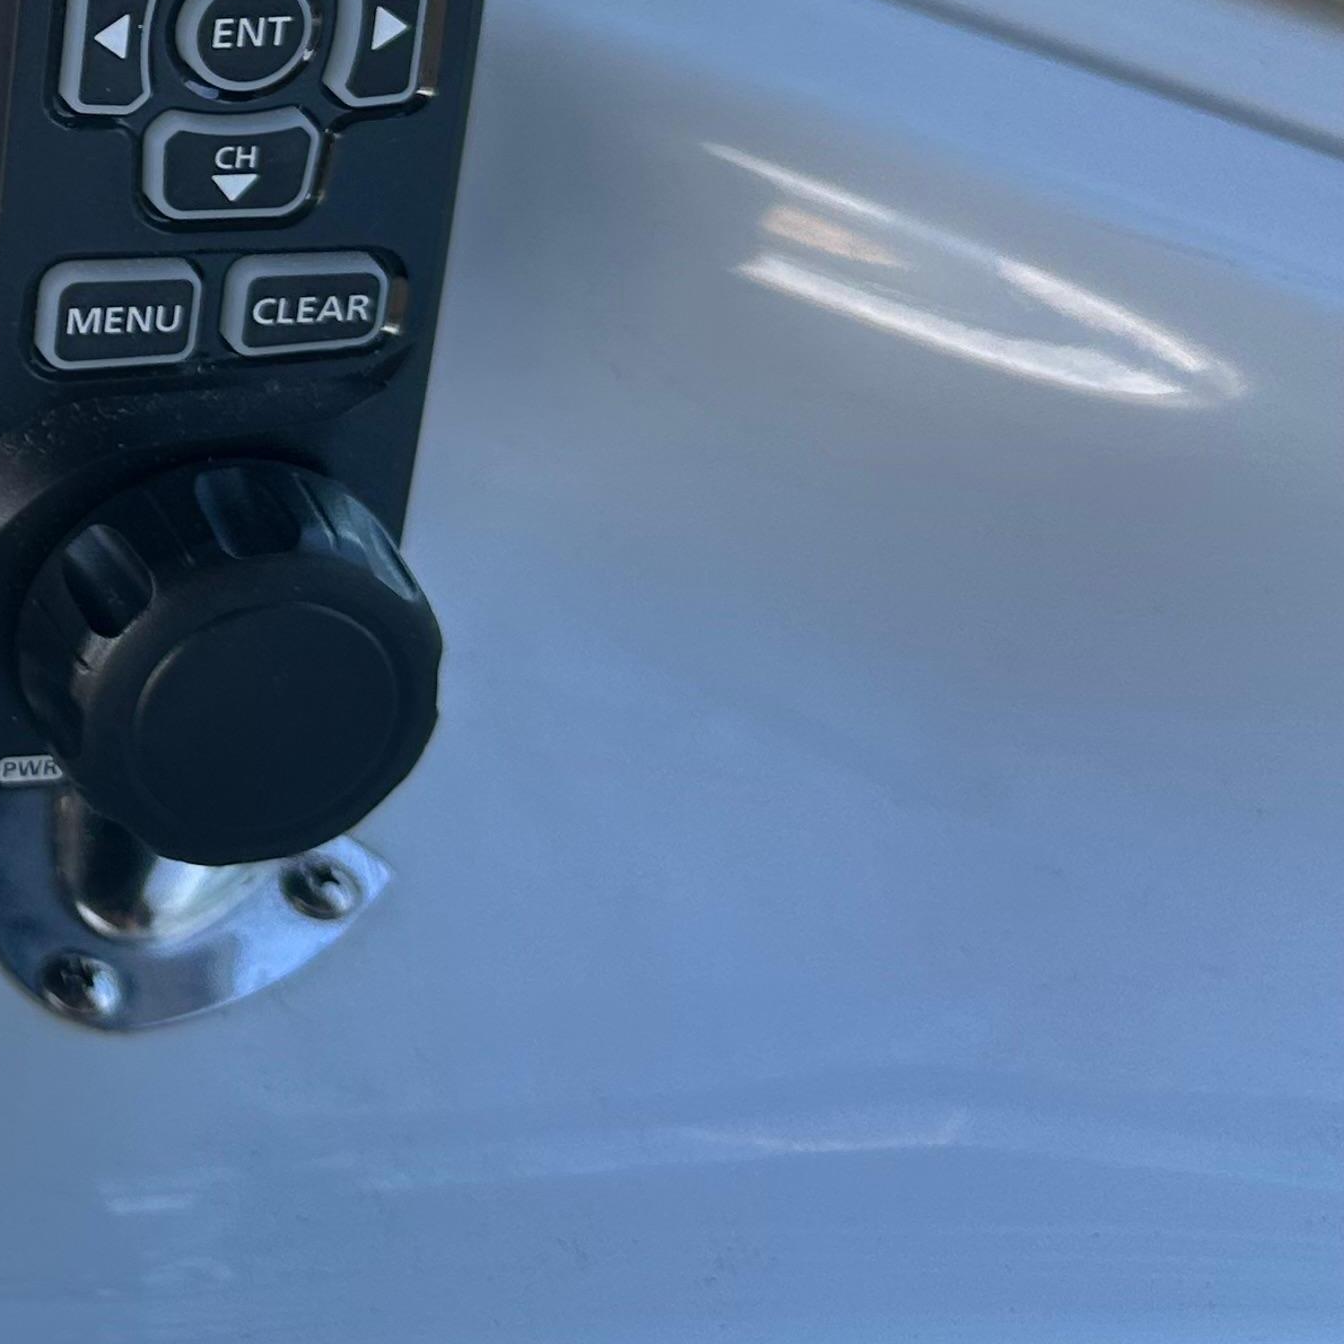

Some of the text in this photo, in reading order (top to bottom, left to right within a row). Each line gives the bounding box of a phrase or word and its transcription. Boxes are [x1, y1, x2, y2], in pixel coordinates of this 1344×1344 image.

[212, 15, 292, 49] ENT
[214, 146, 257, 170] CH
[65, 304, 182, 335] MENU
[252, 293, 370, 325] CLEAR
[0, 757, 59, 779] PWR
